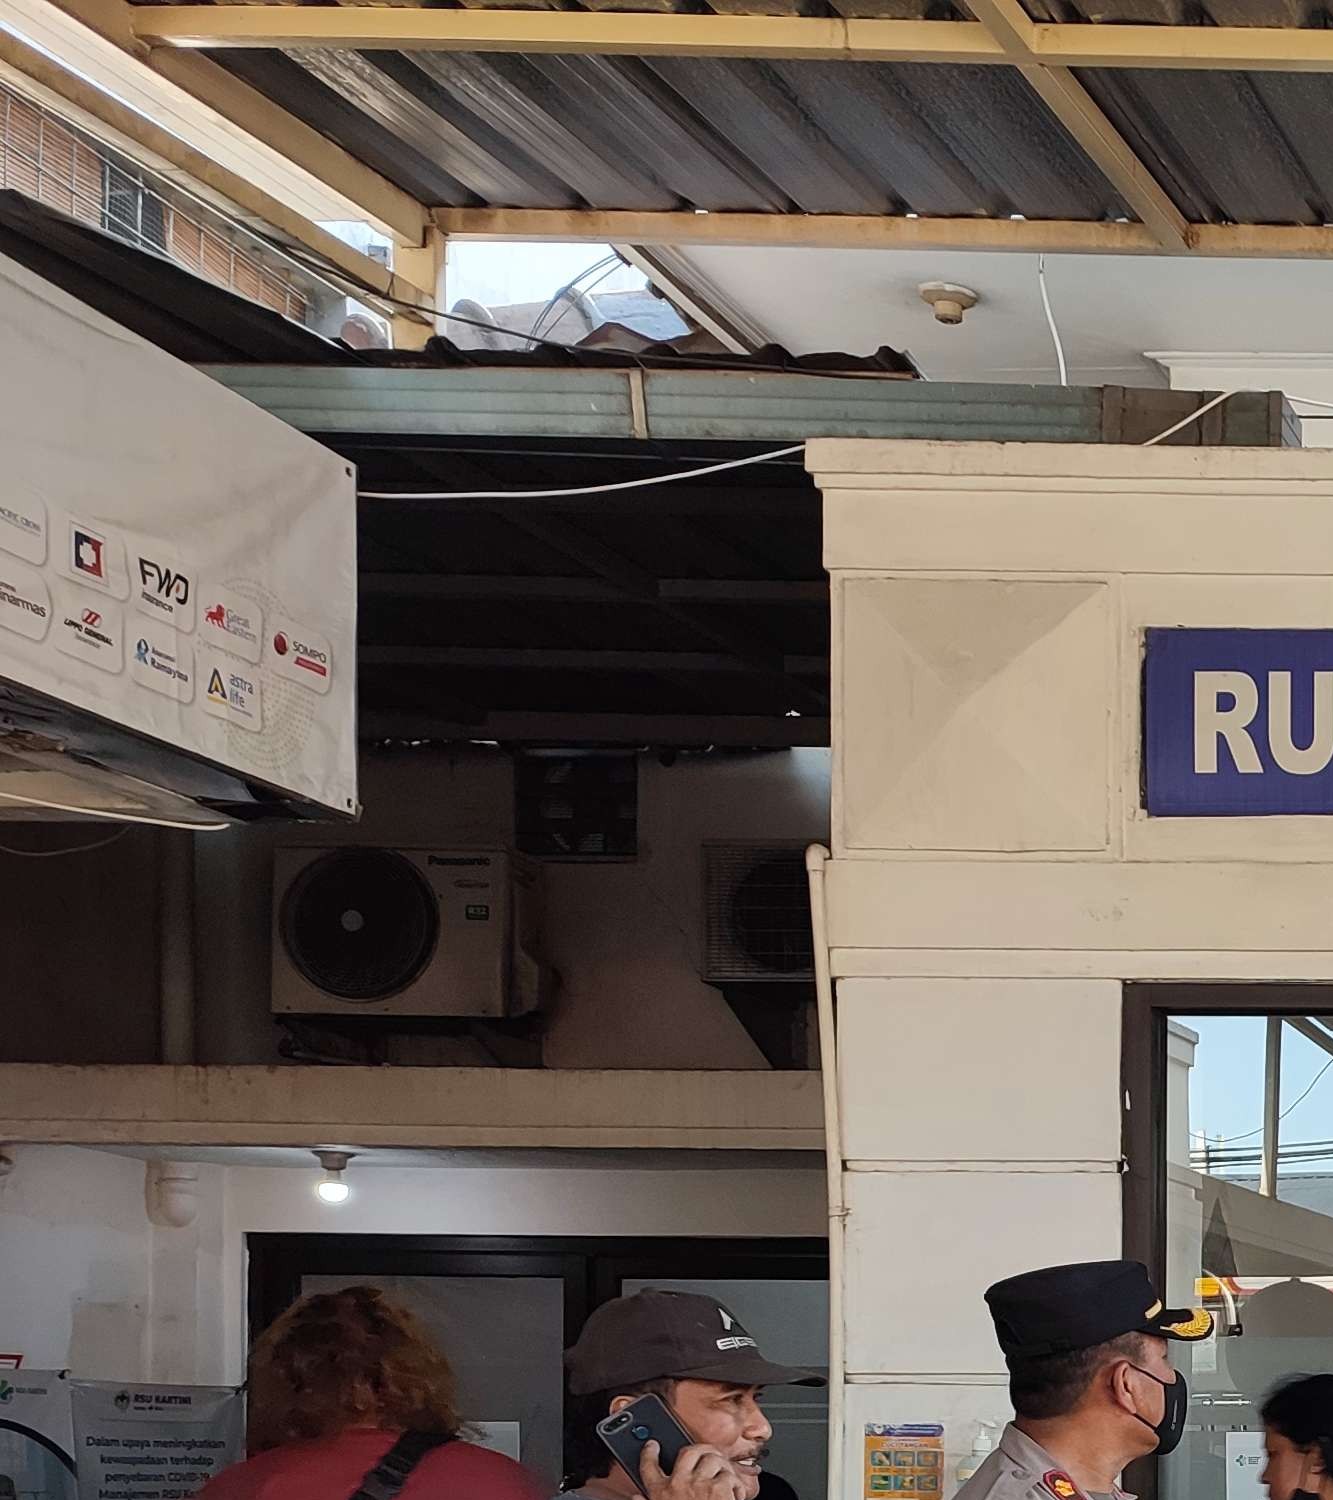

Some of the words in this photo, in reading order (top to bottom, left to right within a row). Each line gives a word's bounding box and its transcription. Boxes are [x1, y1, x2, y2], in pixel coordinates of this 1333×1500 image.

[138, 557, 189, 606] FWD
[292, 639, 328, 664] SOMPO
[229, 674, 255, 695] astra
[229, 689, 246, 708] life
[428, 855, 491, 866] Panasonic
[85, 1435, 120, 1448] Dalam
[122, 1438, 152, 1451] upaya
[152, 1437, 226, 1452] meningkatkan
[170, 1454, 215, 1467] terhadap
